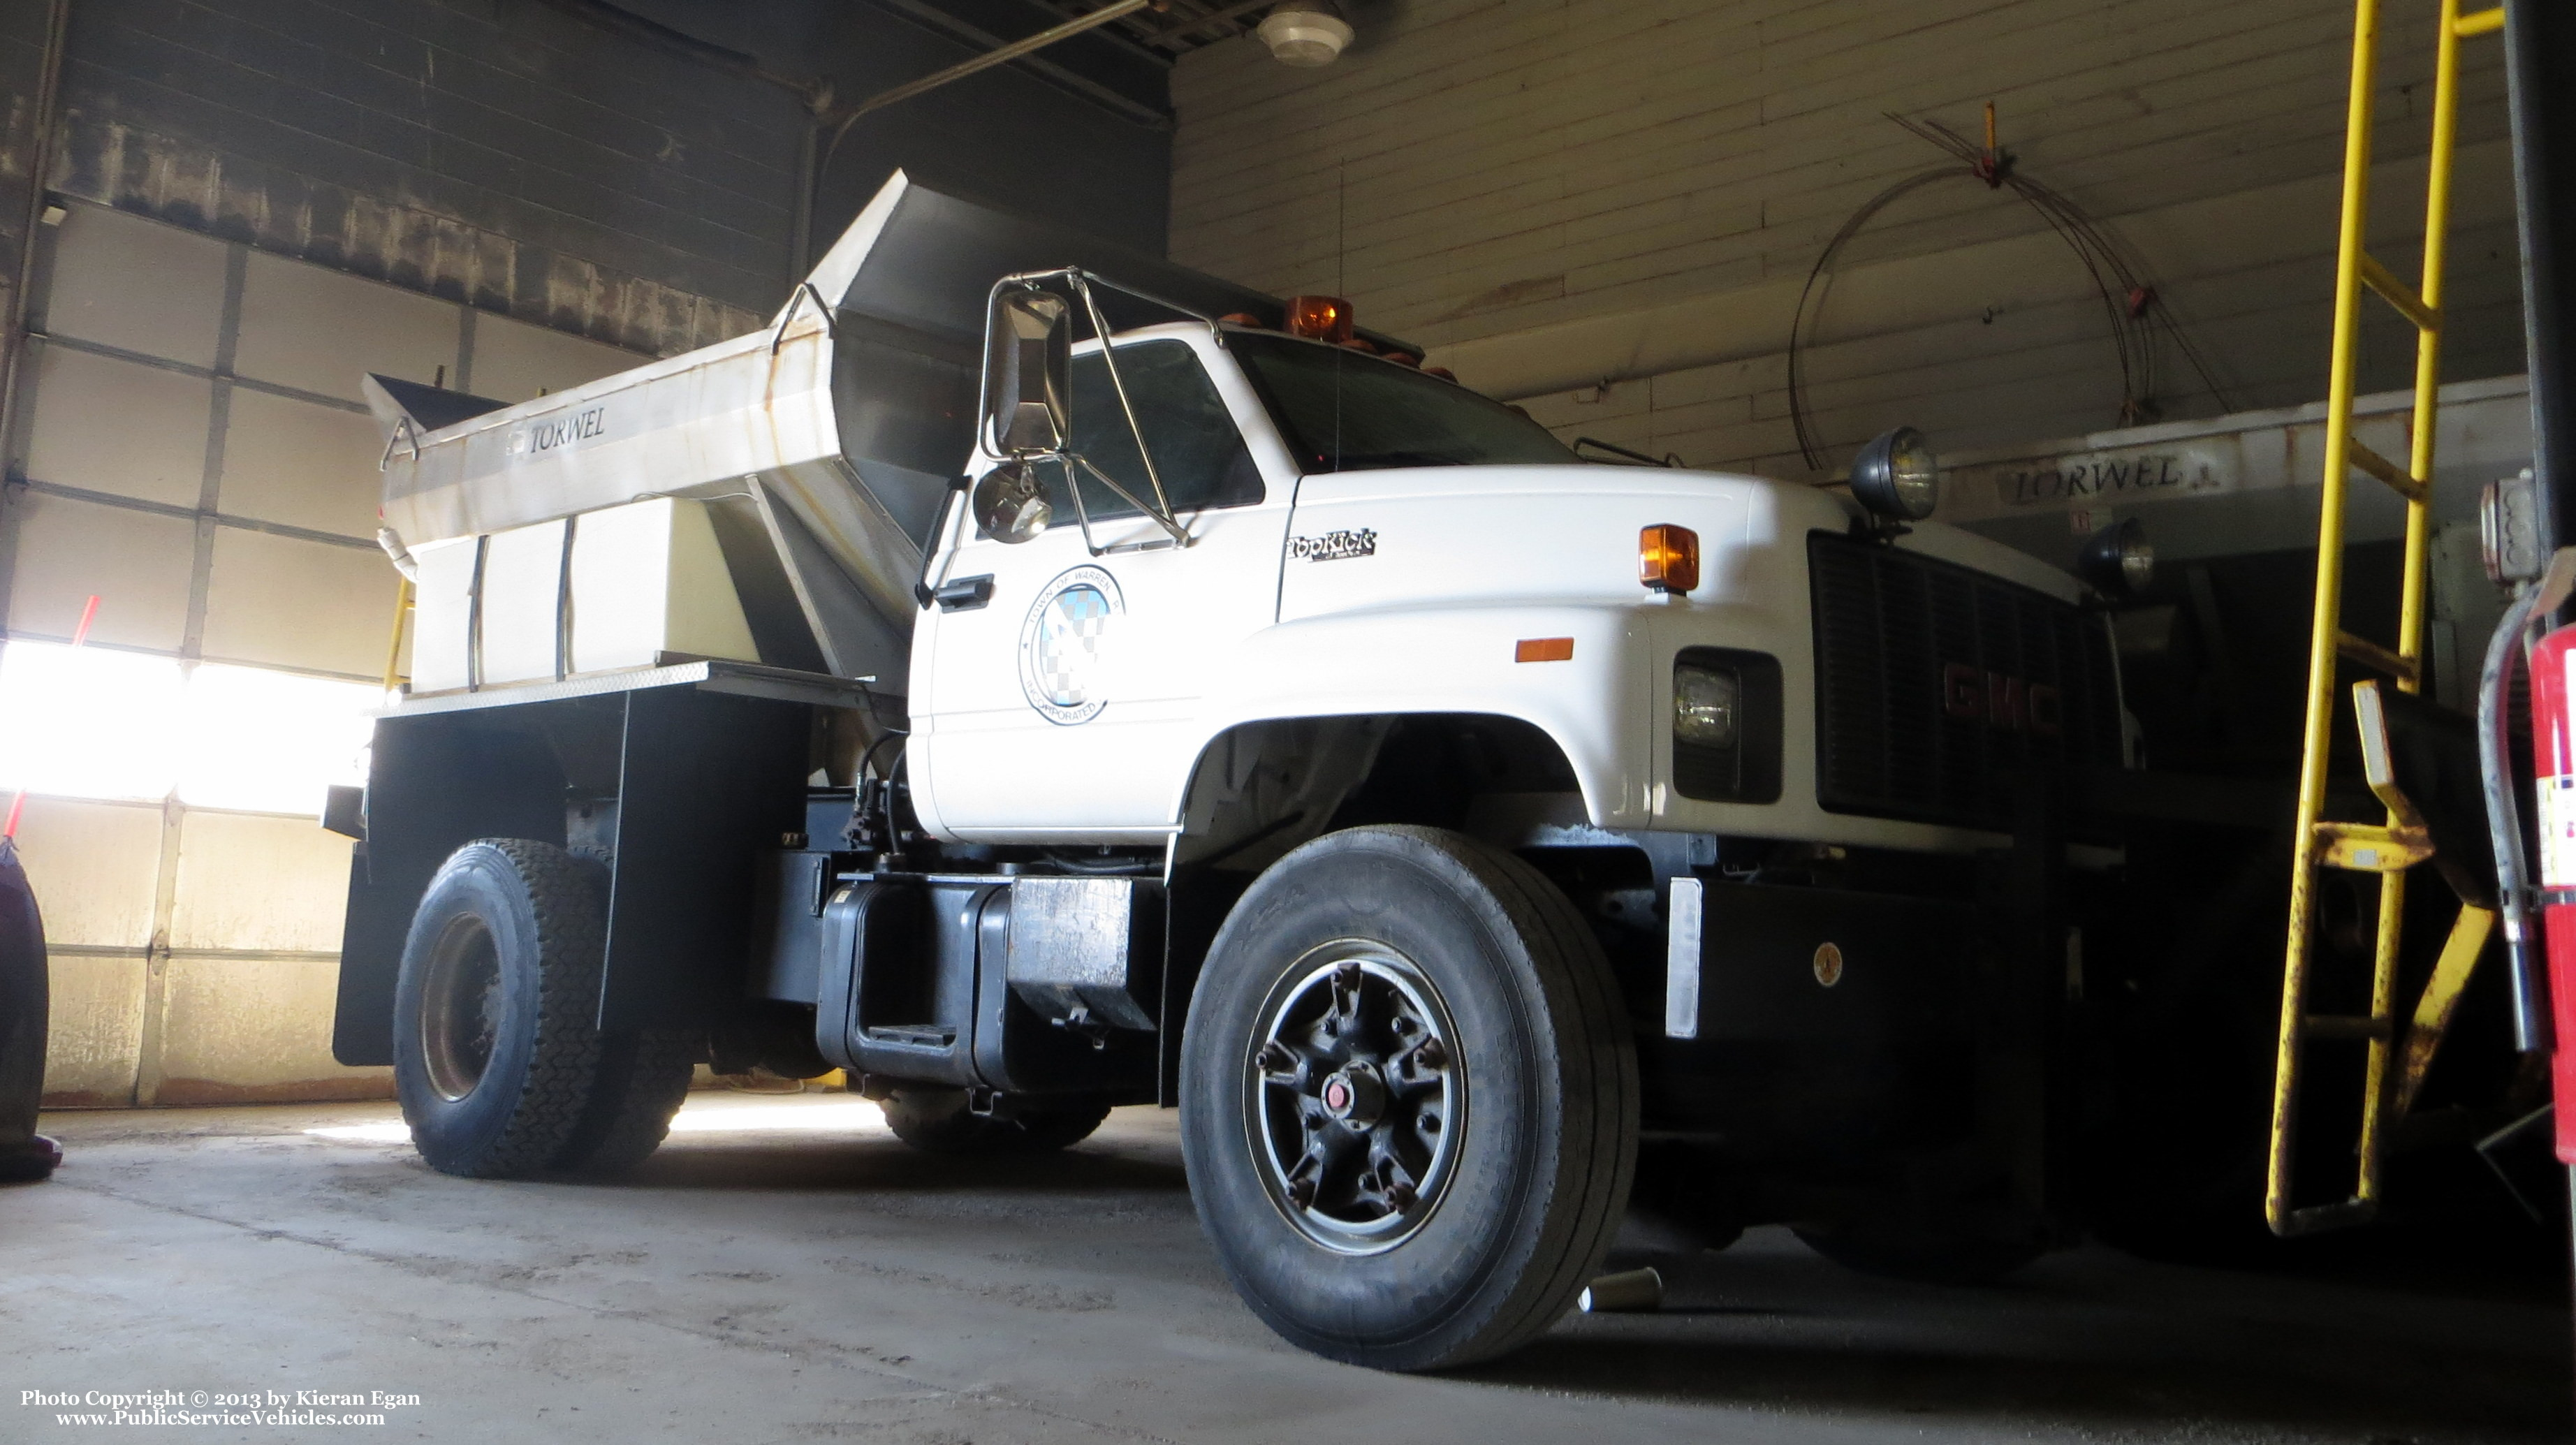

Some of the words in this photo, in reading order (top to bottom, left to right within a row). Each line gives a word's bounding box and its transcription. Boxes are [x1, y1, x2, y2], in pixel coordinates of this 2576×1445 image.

[531, 407, 605, 453] TORWEL
[1029, 588, 1053, 624] TOWN
[1056, 574, 1071, 589] OF
[1027, 680, 1096, 721] INCORPORATED
[1944, 662, 2062, 734] GMC
